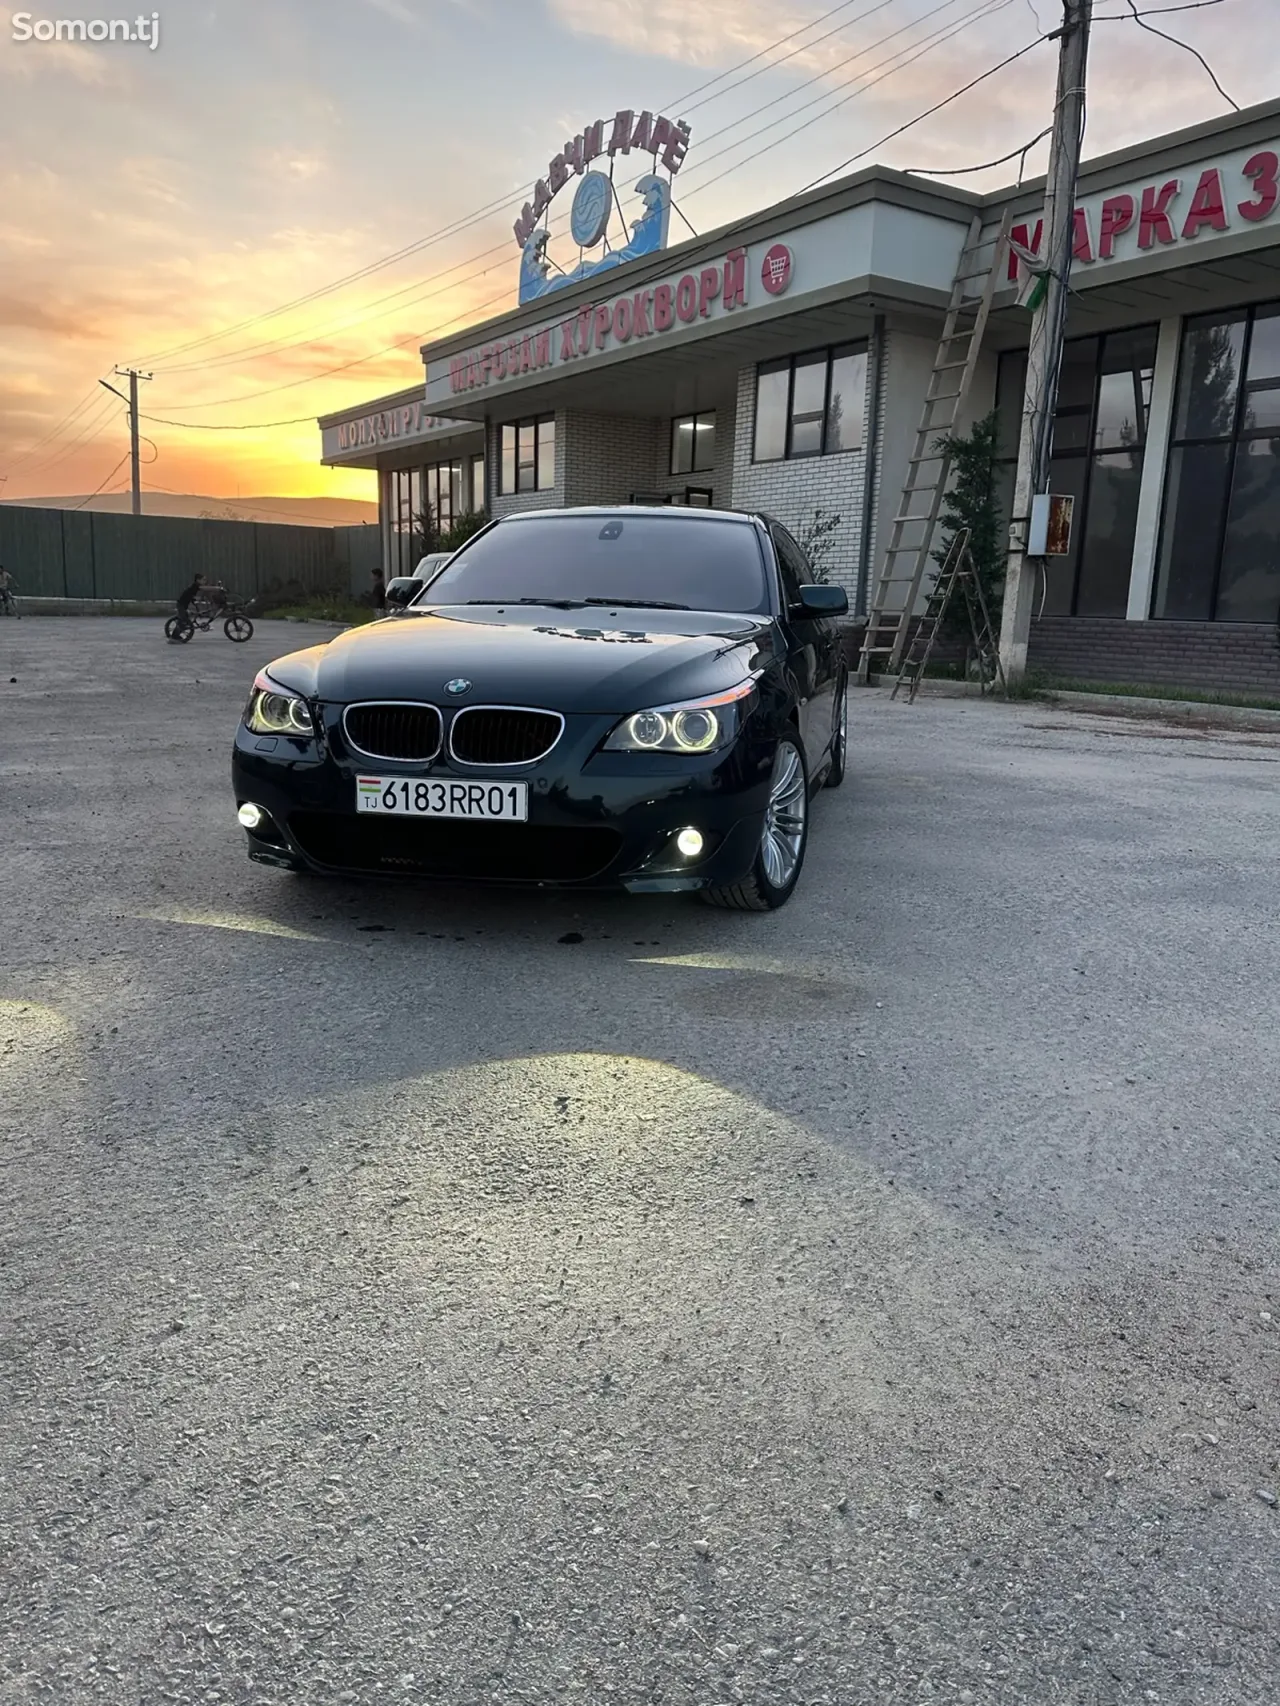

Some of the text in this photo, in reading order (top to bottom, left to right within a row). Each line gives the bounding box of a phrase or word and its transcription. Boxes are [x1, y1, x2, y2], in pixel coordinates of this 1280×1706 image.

[607, 110, 691, 175] ДАРЁ
[364, 781, 518, 816] TJ 6183RR01
